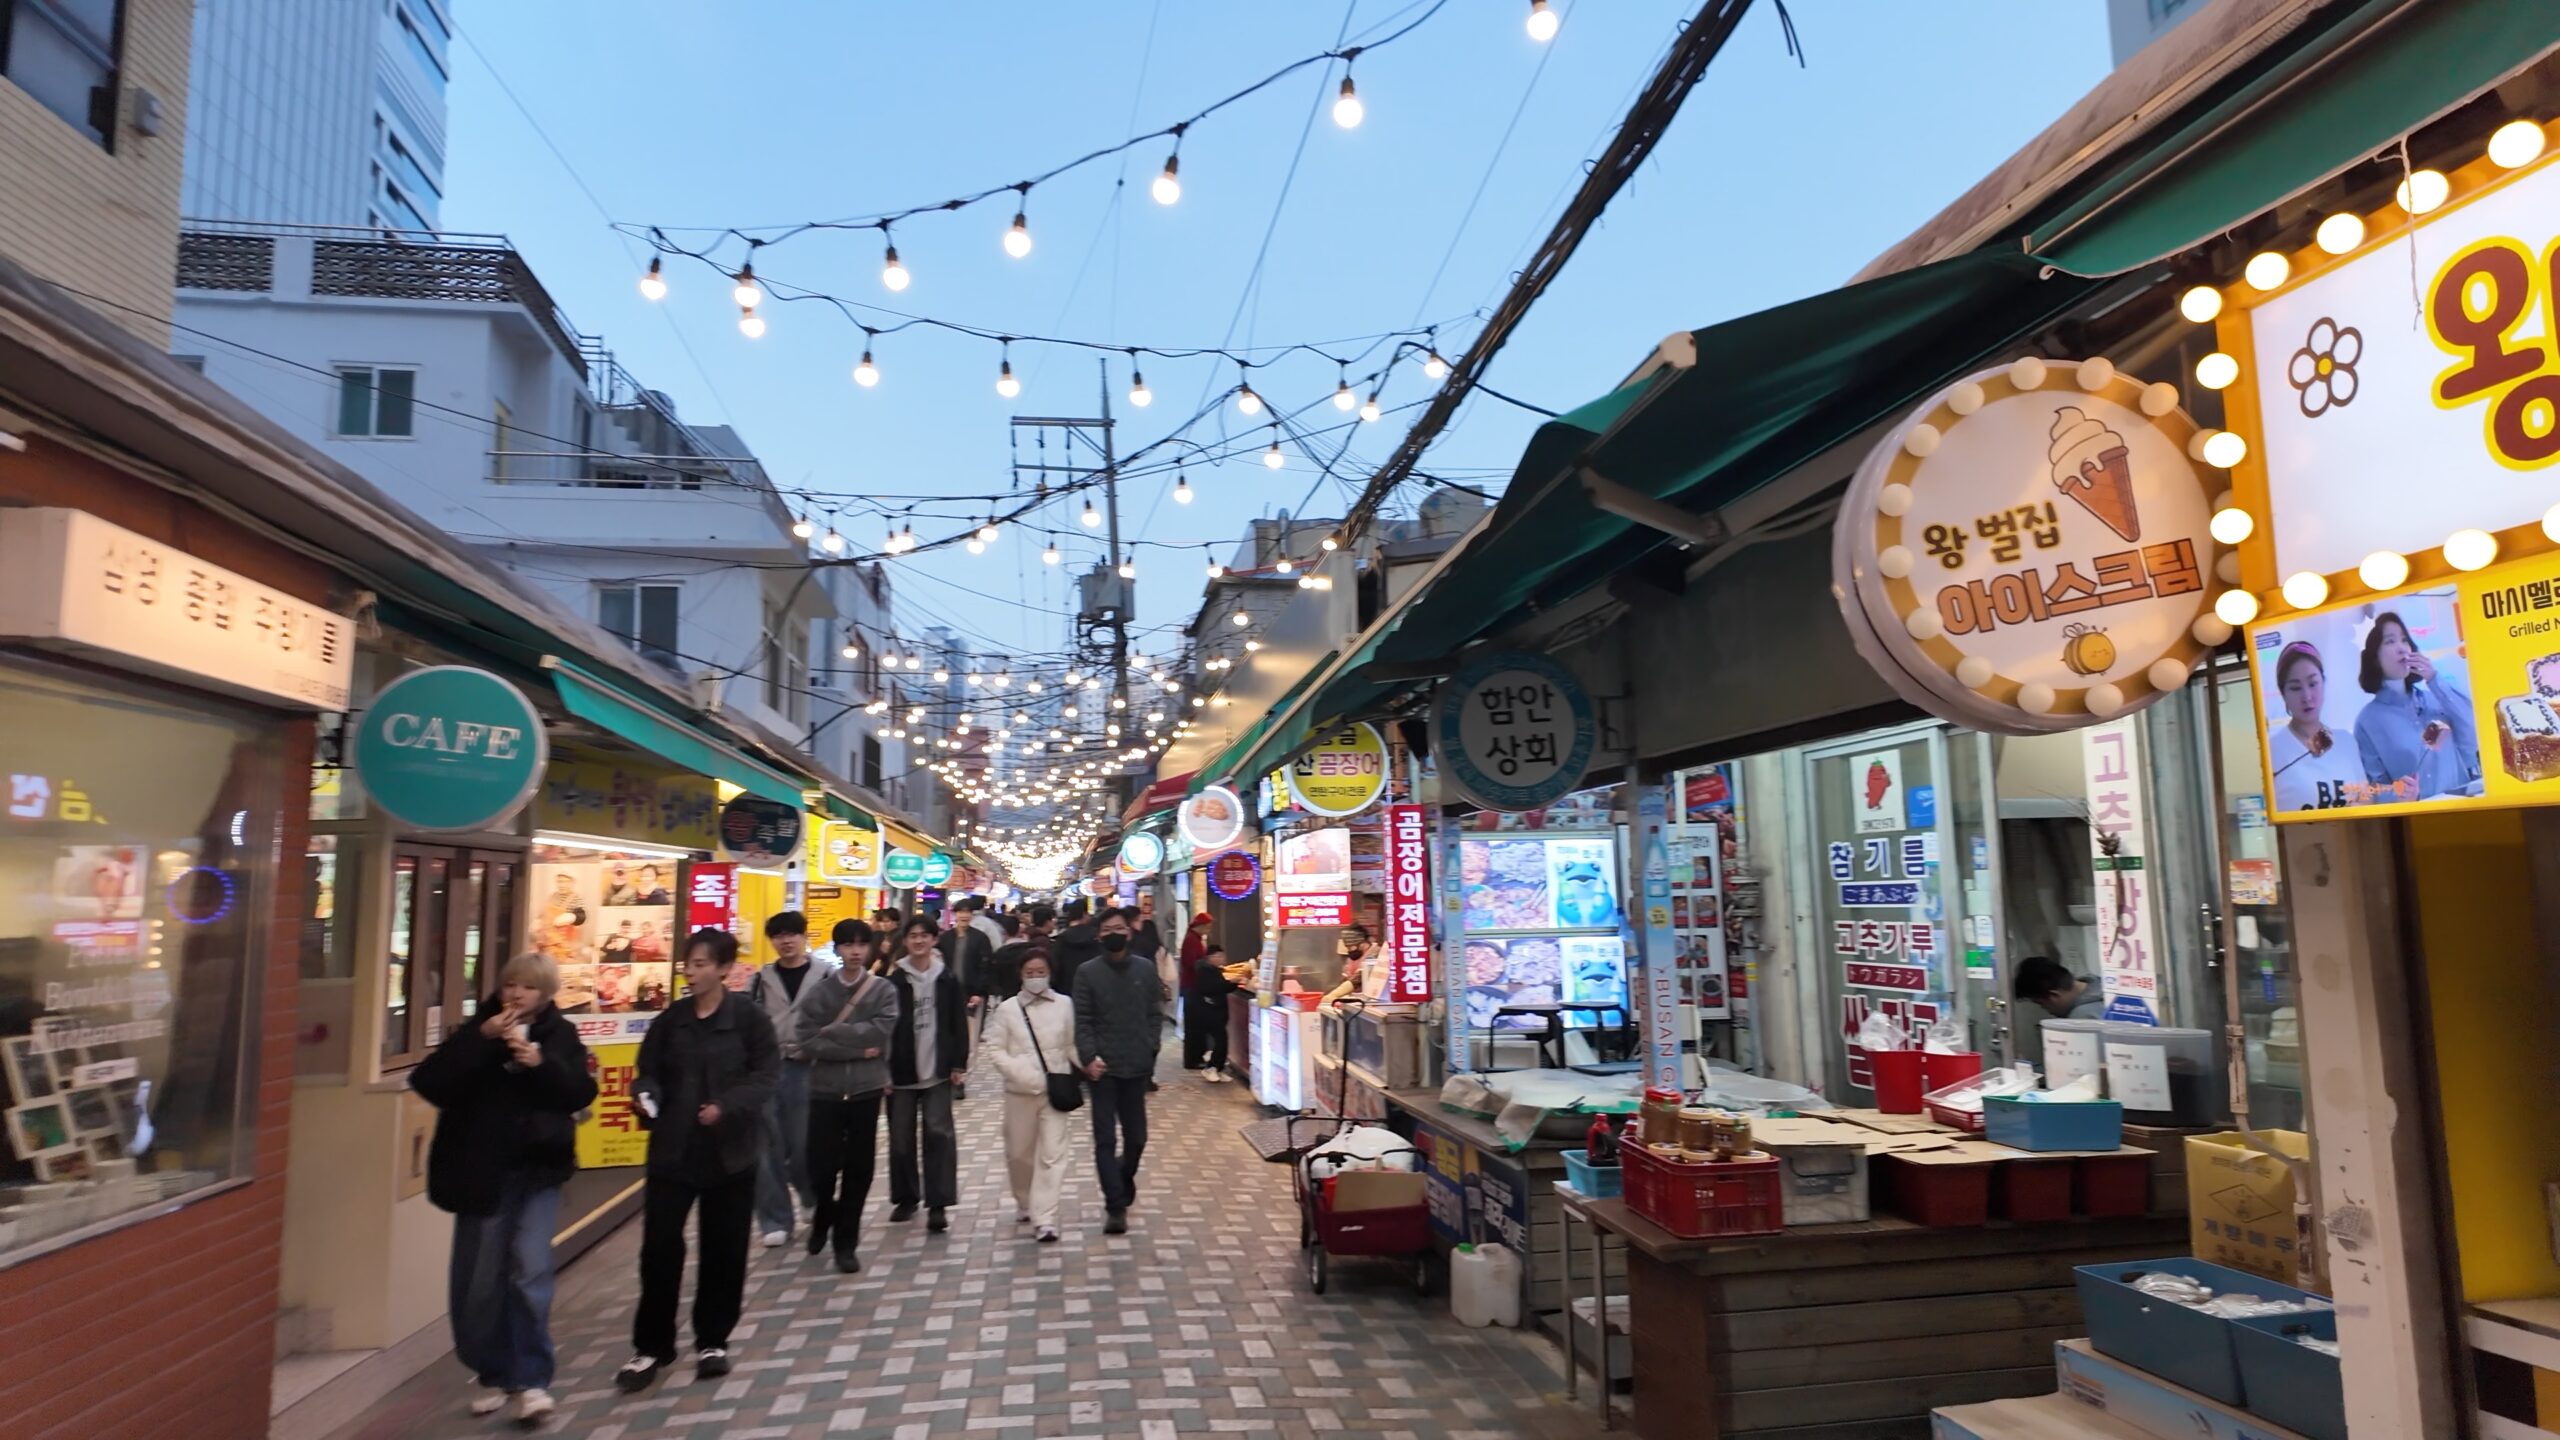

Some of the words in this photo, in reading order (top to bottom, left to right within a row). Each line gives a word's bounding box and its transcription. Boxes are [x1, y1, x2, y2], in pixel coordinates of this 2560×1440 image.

[1922, 522, 1969, 570] 왕
[1976, 501, 2061, 563] 벌집
[1936, 538, 2204, 635] 아이스크림
[2481, 577, 2560, 619] 마시멜
[2508, 618, 2551, 638] Grilled
[1478, 684, 1555, 725] 함안
[381, 713, 522, 760] CAFE
[1485, 732, 1558, 777] 상회
[1828, 836, 1928, 880] 참기름
[1834, 919, 1936, 964] 고추가루
[1848, 966, 1920, 986] トウガラシ
[578, 1019, 619, 1036] 포장
[1655, 978, 1675, 1058] BUSAN
